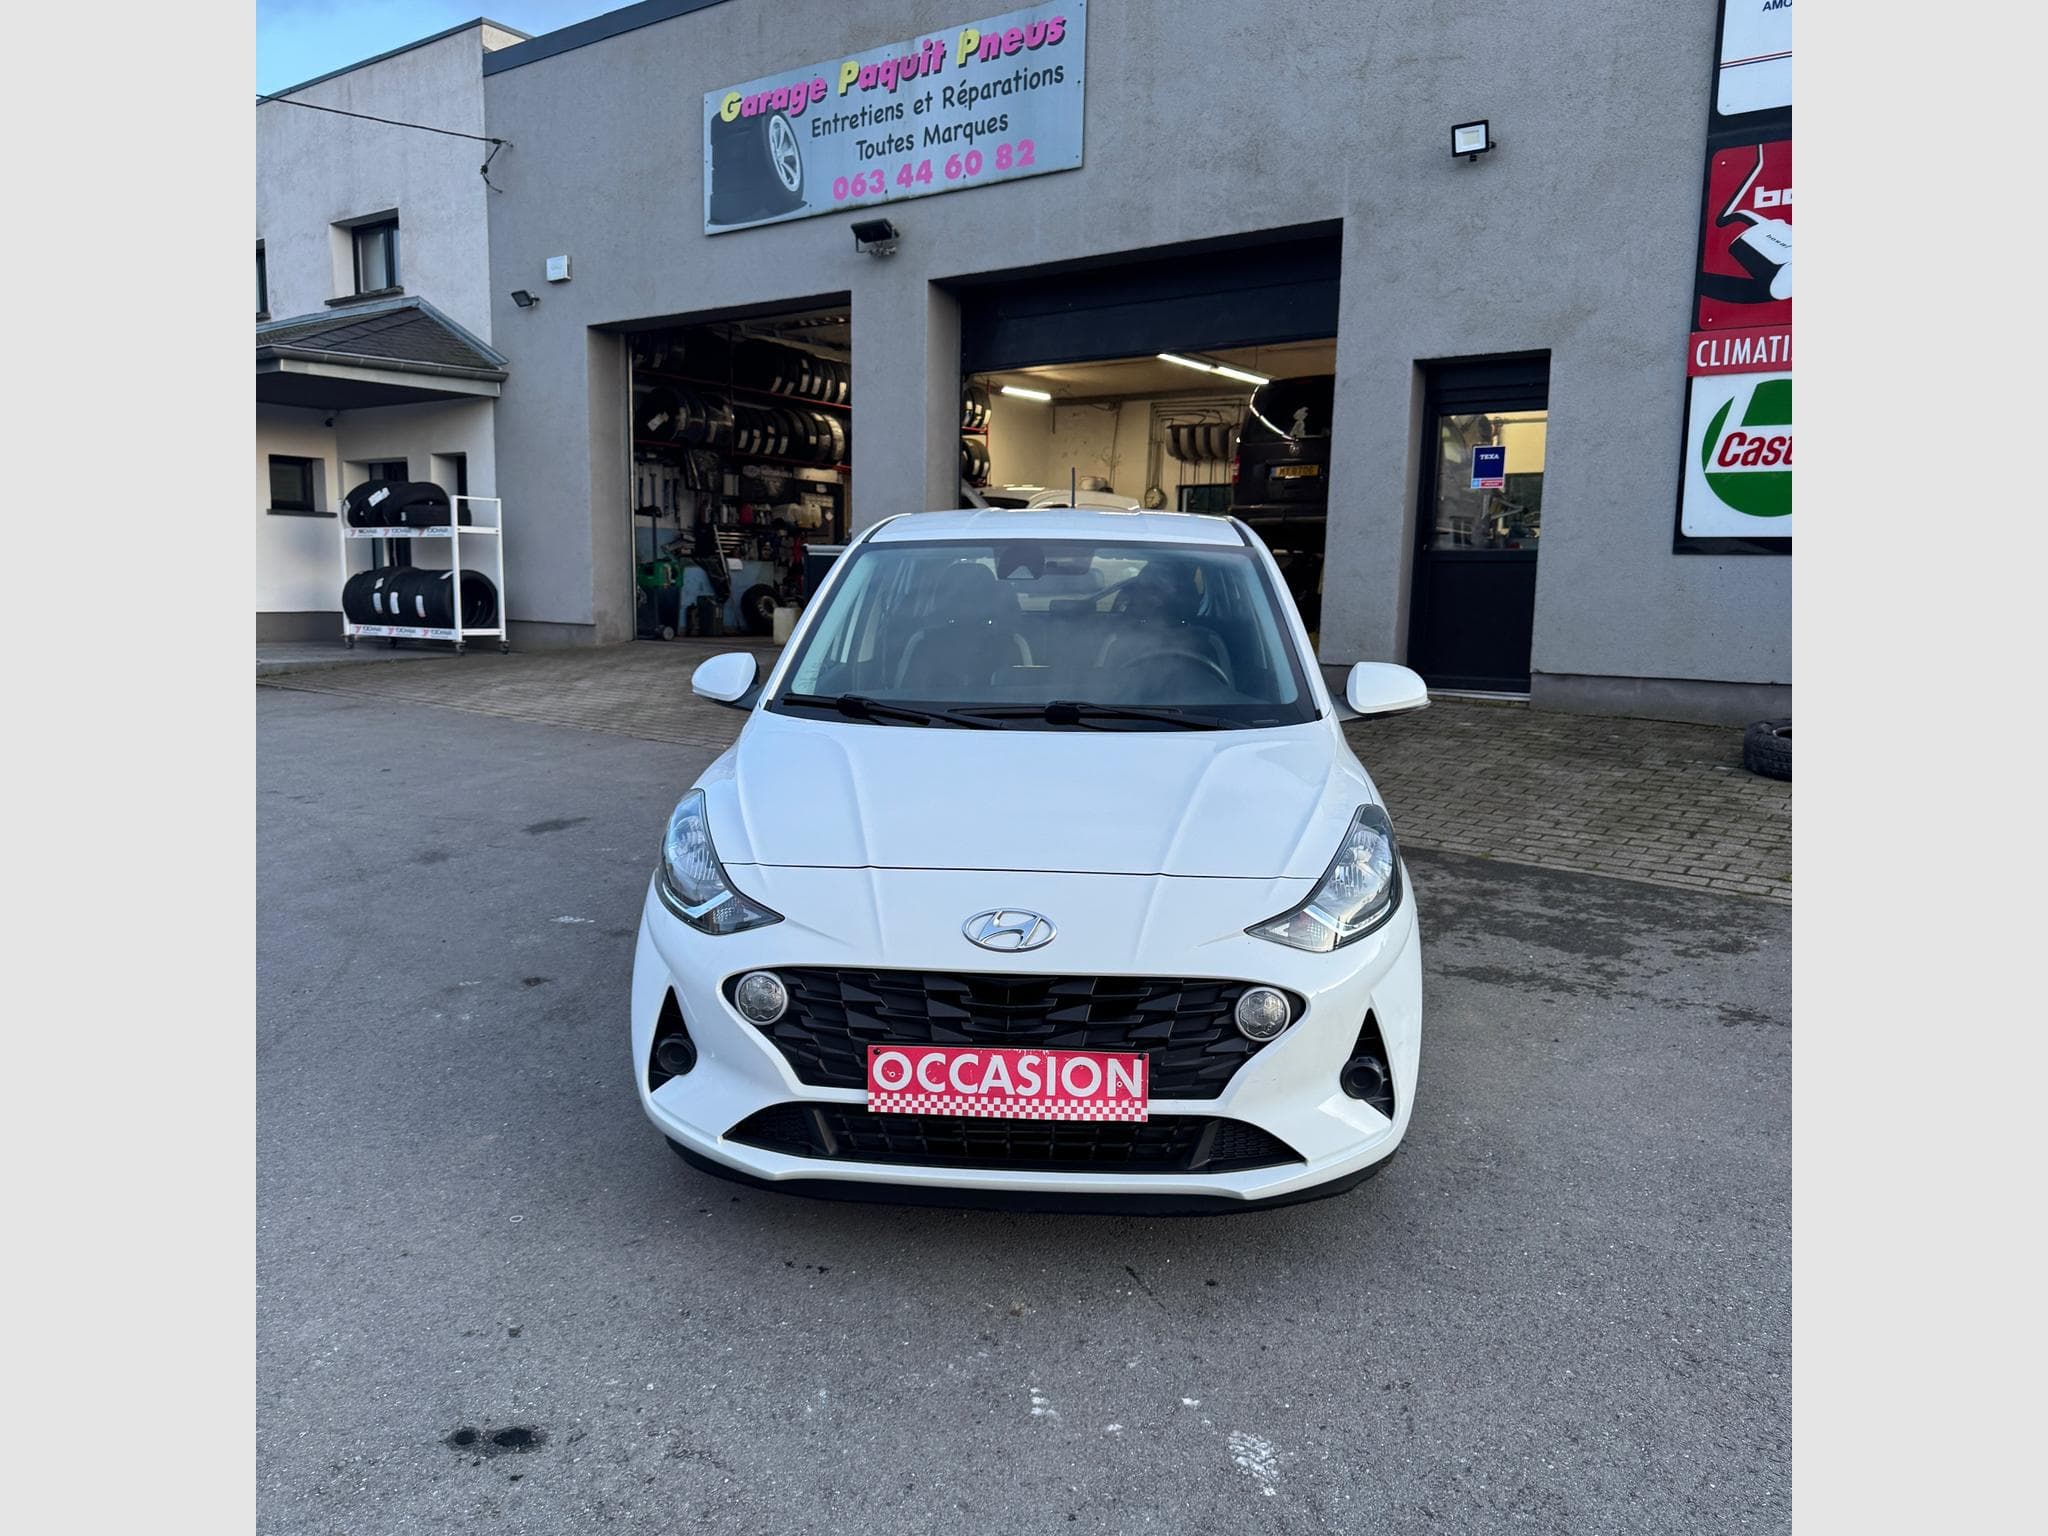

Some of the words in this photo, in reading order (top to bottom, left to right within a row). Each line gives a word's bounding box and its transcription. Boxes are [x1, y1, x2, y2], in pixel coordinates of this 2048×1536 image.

[720, 75, 827, 123] Garage
[838, 39, 946, 96] Paquit
[957, 16, 1067, 67] Pneus
[812, 102, 904, 138] Entretiens
[913, 95, 933, 115] et
[943, 63, 1065, 110] Réparations
[856, 131, 914, 161] Toutes
[923, 112, 1009, 146] Marques
[832, 169, 886, 201] 063
[896, 159, 933, 188] 44
[945, 149, 984, 180] 60
[995, 138, 1036, 170] 82
[1696, 335, 1792, 367] CLIMATI
[1479, 453, 1500, 461] TEXA
[872, 1051, 1143, 1098] OCCASION
